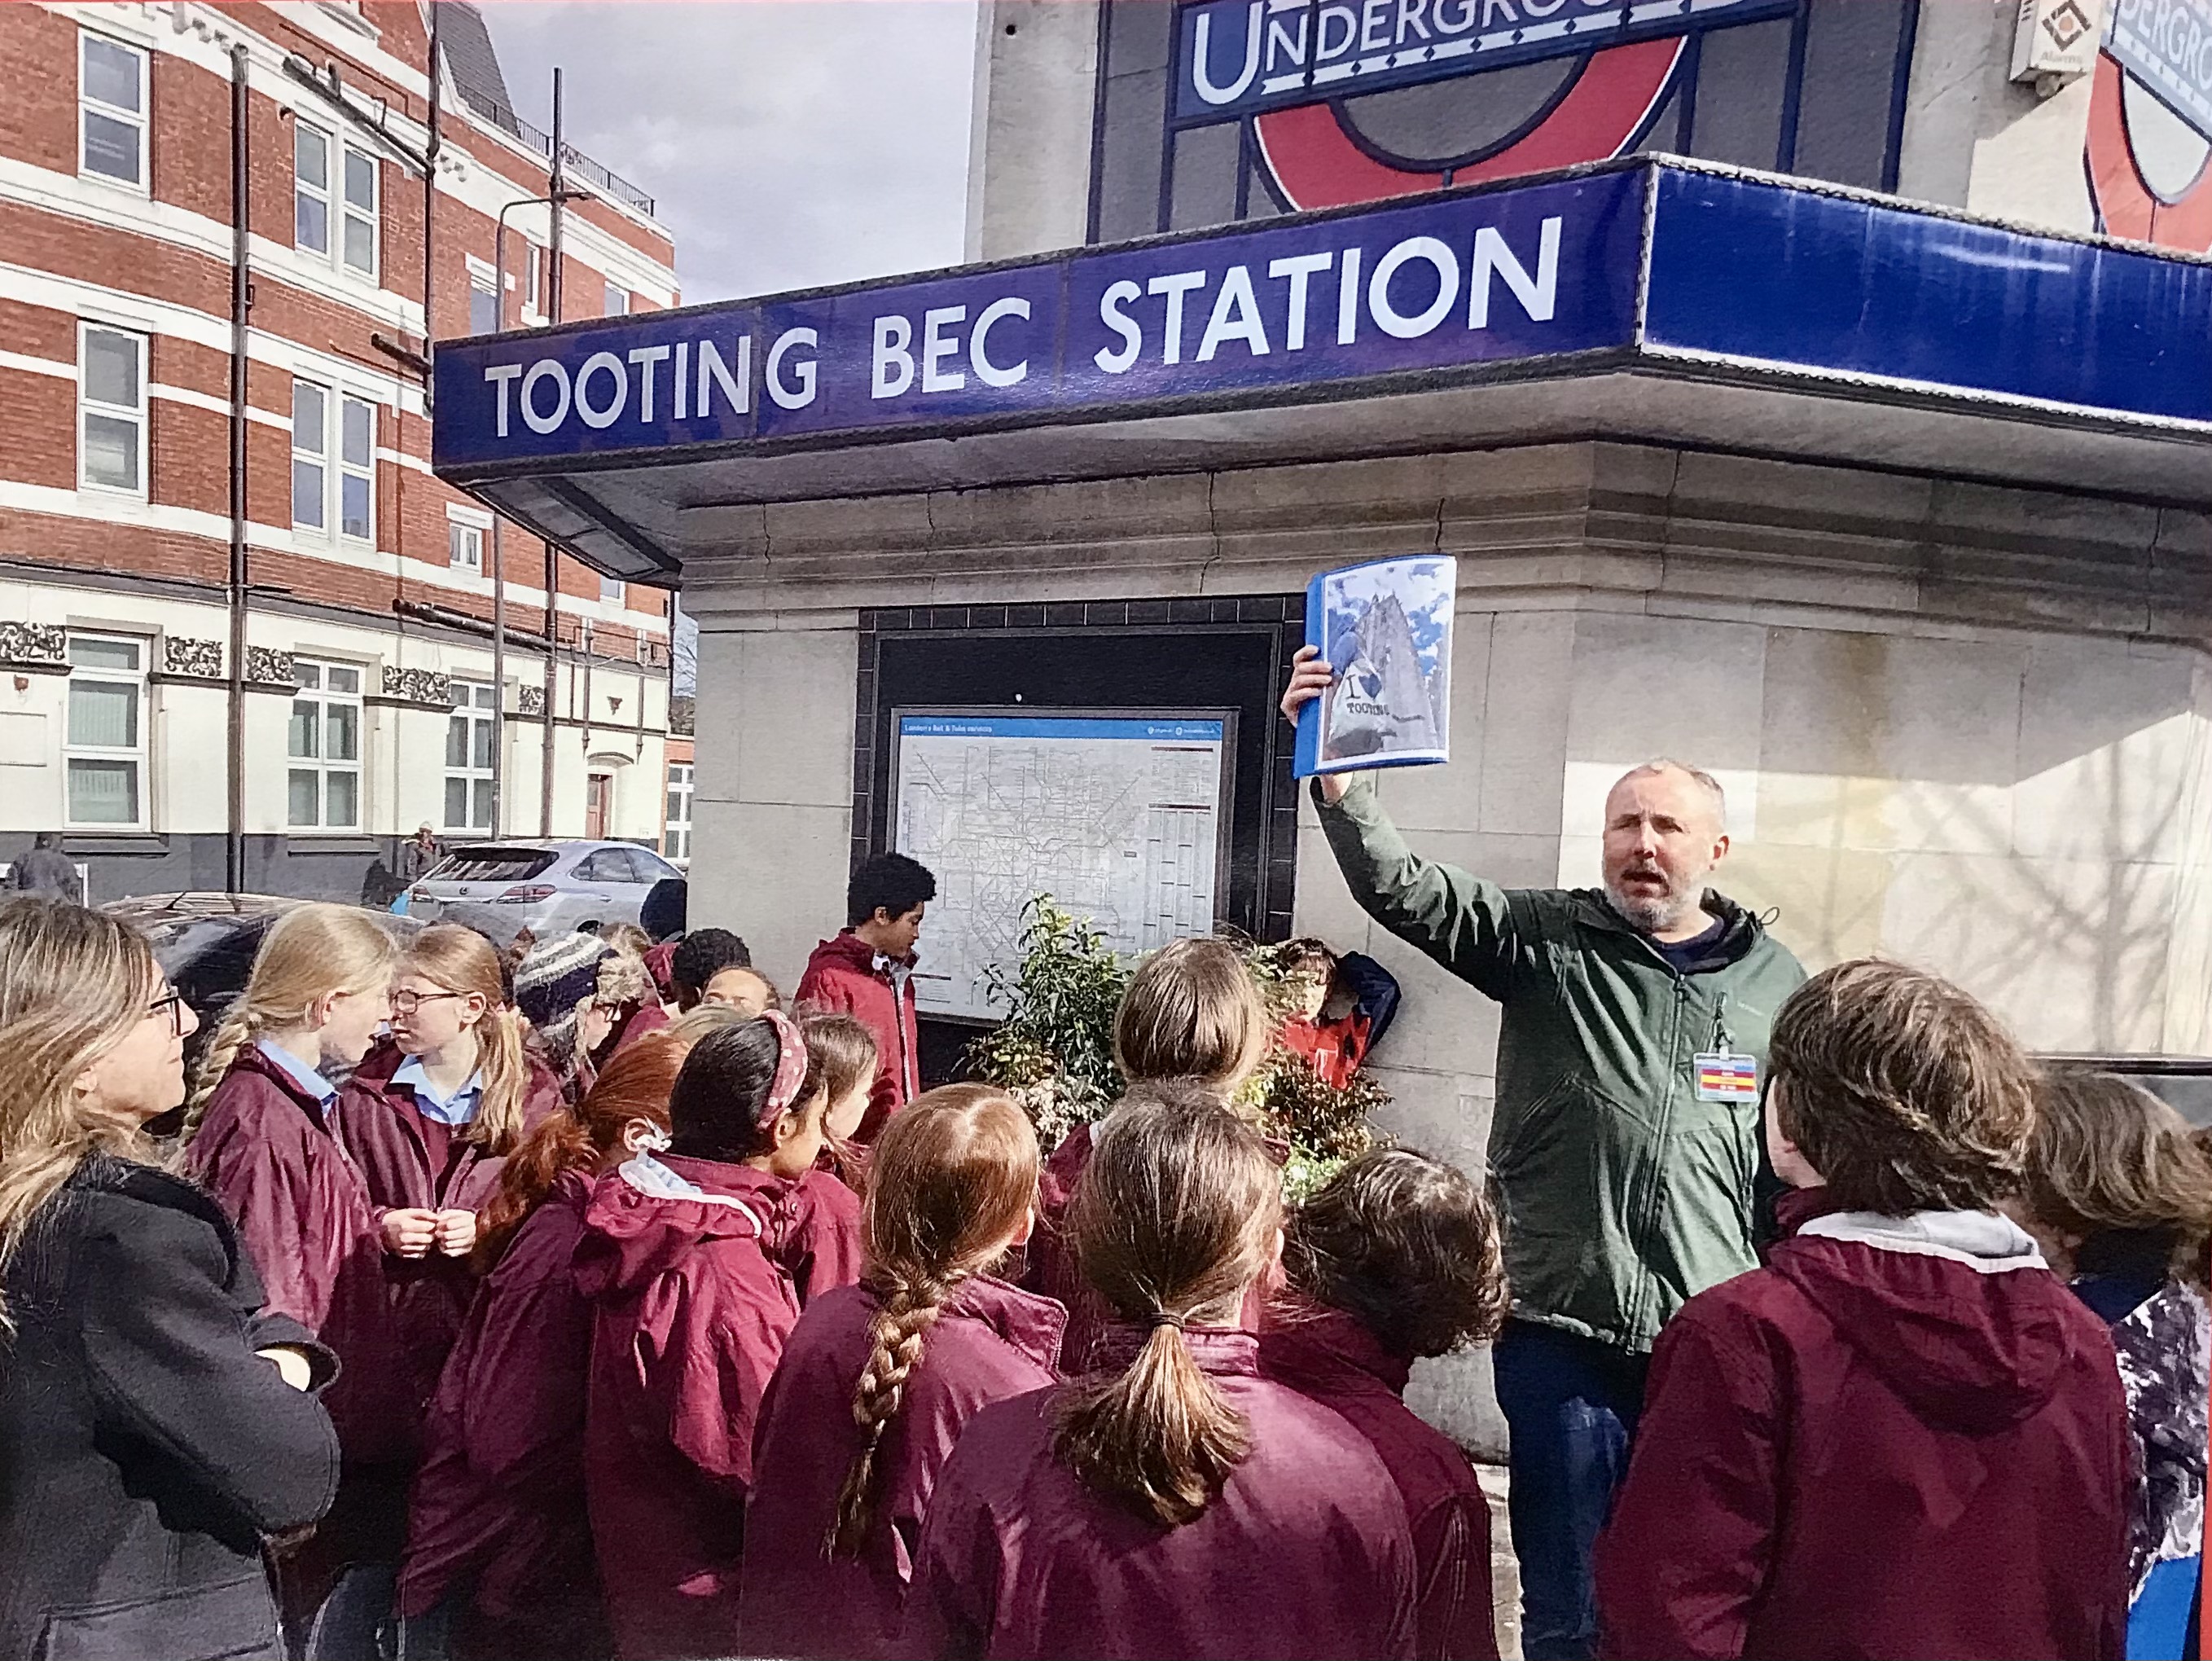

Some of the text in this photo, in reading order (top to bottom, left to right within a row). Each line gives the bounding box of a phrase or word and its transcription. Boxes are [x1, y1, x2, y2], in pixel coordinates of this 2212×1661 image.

[1193, 0, 1613, 104] UNDERGR
[484, 216, 1563, 437] TOOTING BEC STATION
